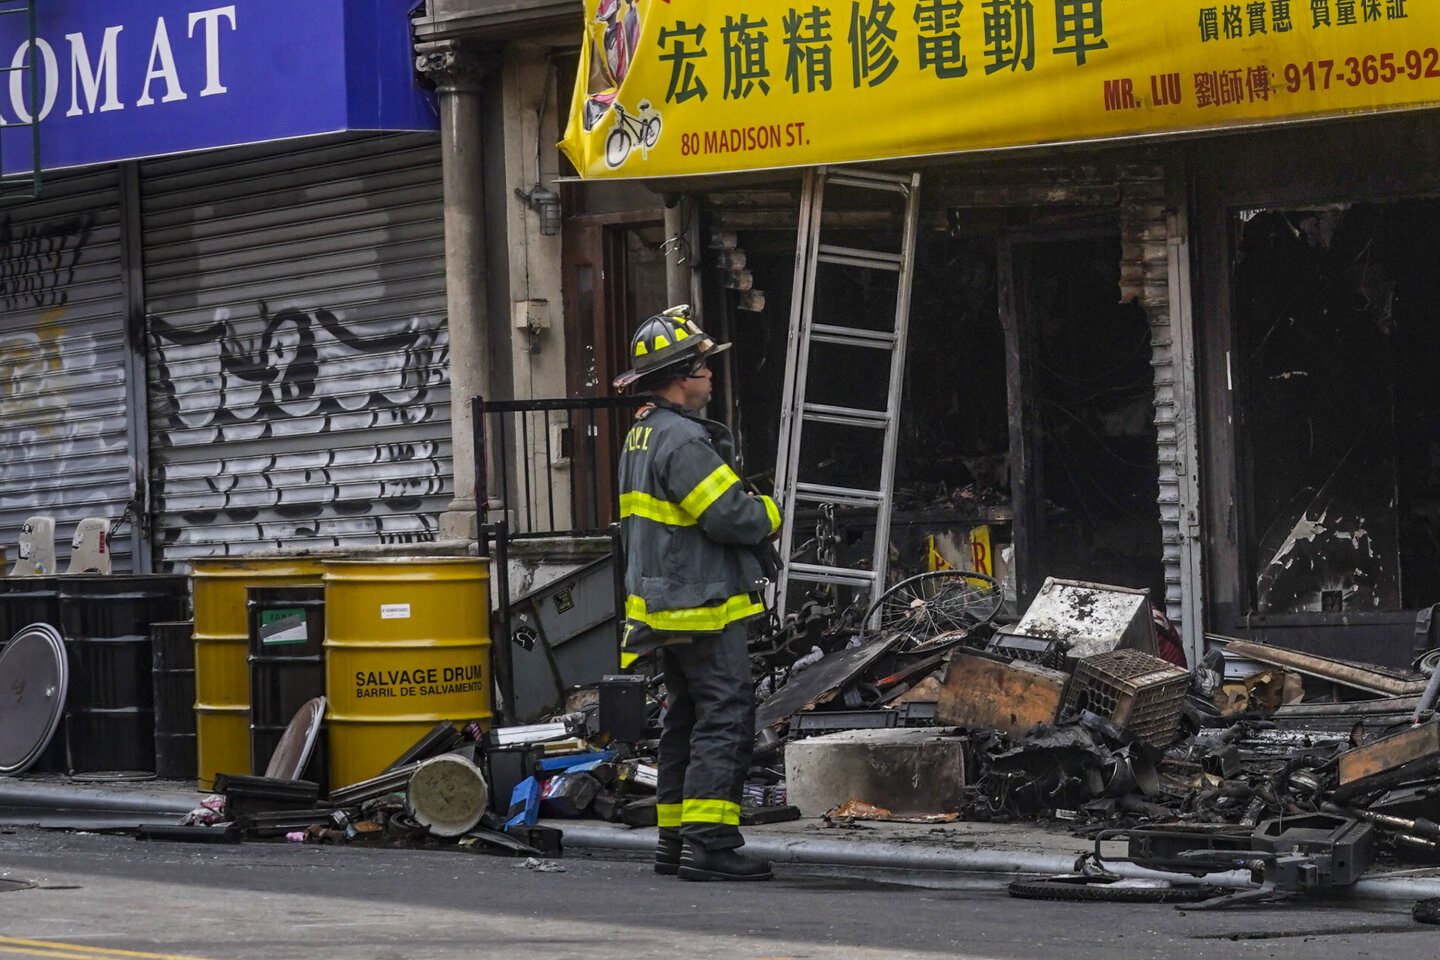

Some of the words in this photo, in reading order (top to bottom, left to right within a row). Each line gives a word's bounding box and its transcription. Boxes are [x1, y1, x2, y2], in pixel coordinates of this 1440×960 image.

[0, 5, 237, 126] OMAT
[1104, 79, 1142, 112] MR.
[1151, 72, 1182, 108] LIU
[682, 133, 700, 157] 80
[705, 125, 782, 155] MADISON
[786, 121, 811, 147] ST.
[356, 668, 438, 686] SALVAGE
[443, 665, 482, 683] DRUM
[356, 687, 396, 699] BARRIL
[400, 686, 417, 697] DE
[420, 681, 483, 696] SALVAMENTO
